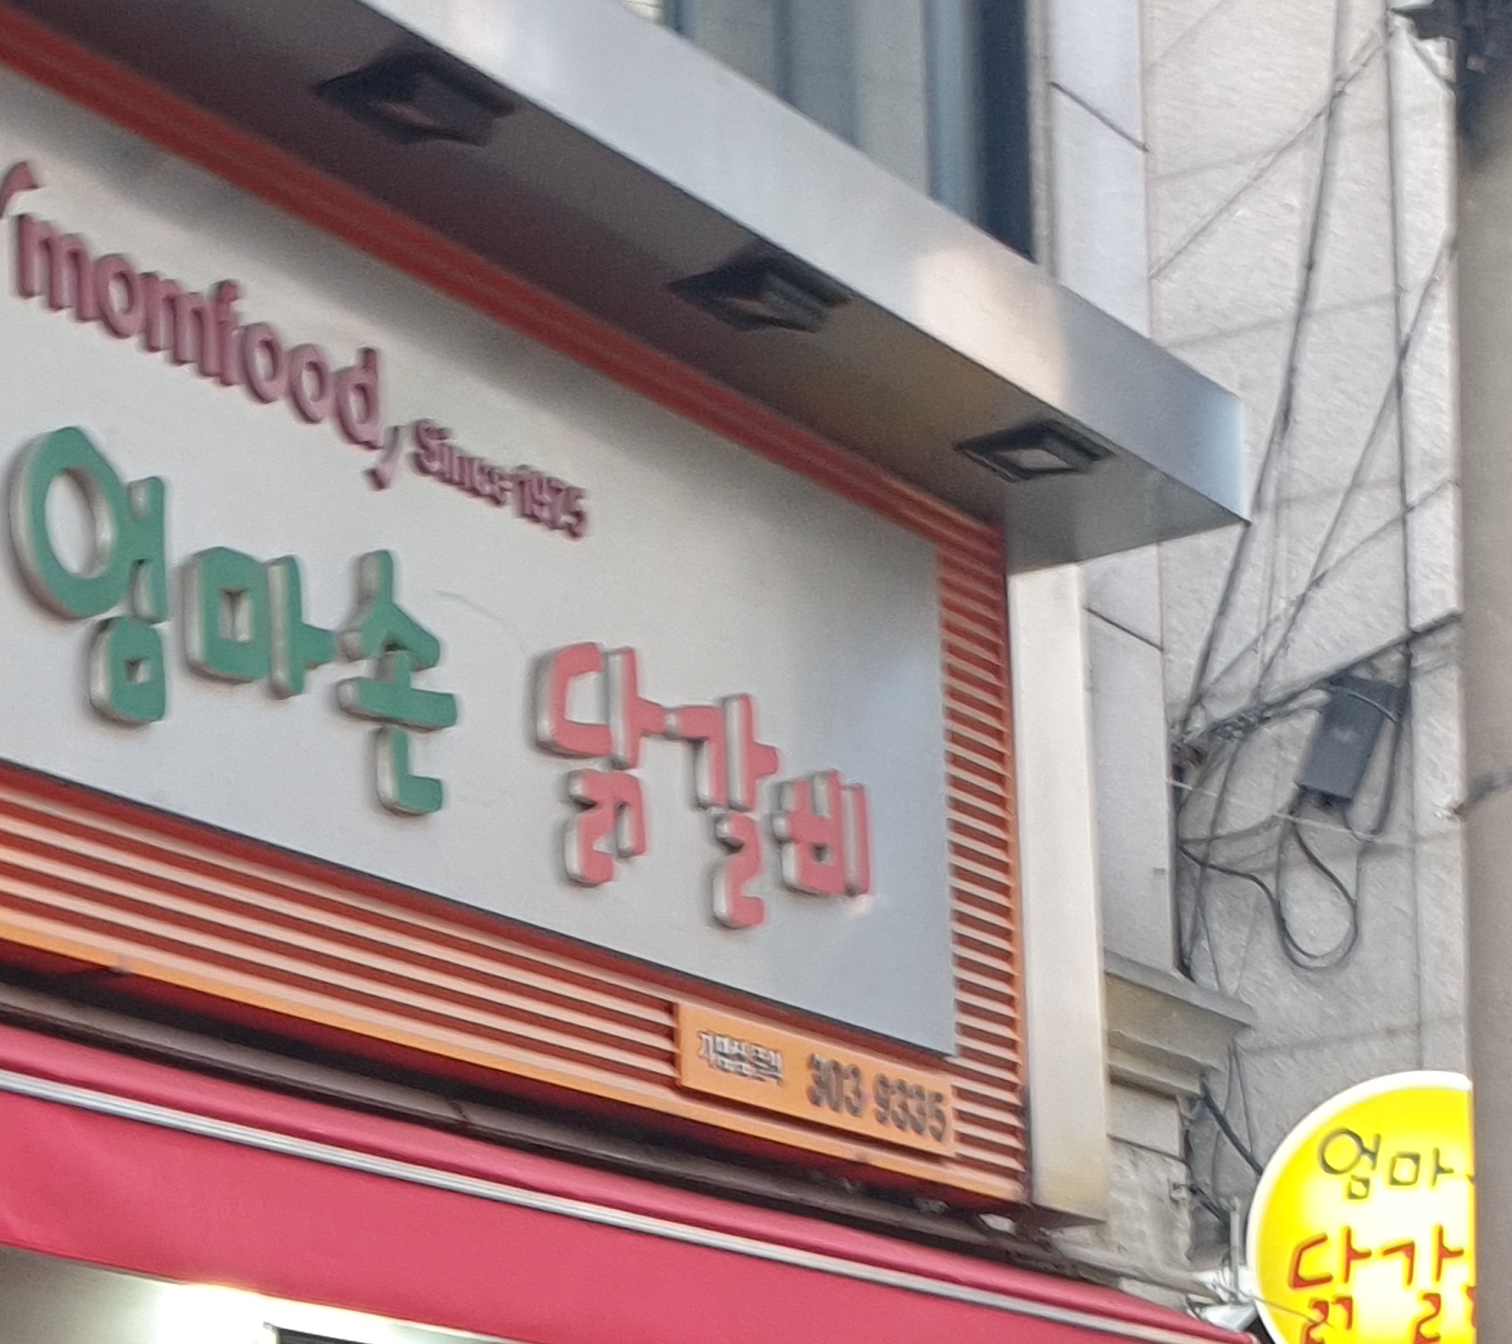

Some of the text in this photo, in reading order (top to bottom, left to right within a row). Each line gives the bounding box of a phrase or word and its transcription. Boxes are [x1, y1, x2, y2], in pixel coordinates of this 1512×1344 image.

[13, 208, 387, 450] momfood
[7, 424, 871, 930] 엄마손 닭갈비
[1317, 1125, 1474, 1200] 엄마
